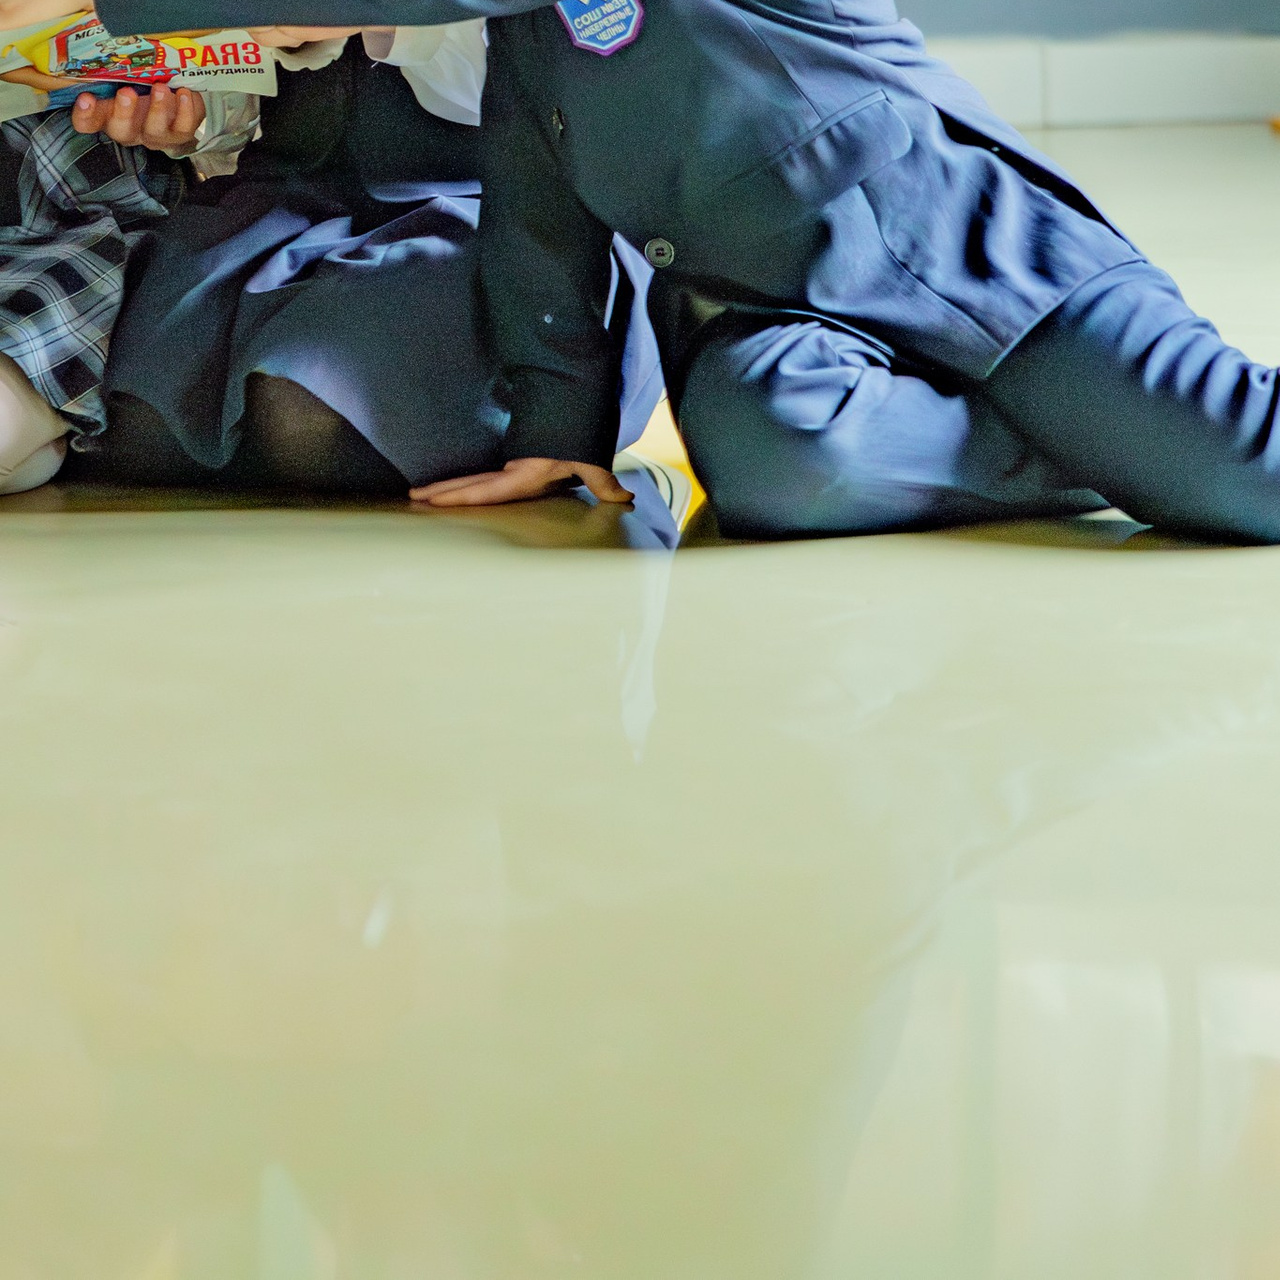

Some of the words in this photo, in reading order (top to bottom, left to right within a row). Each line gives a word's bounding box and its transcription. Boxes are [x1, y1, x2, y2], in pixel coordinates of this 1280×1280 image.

[574, 7, 602, 29] СОШ
[596, 22, 626, 41] ЧЕЛНЫ
[178, 41, 262, 69] РАЯЗ
[181, 67, 265, 77] Гайнутдинов
